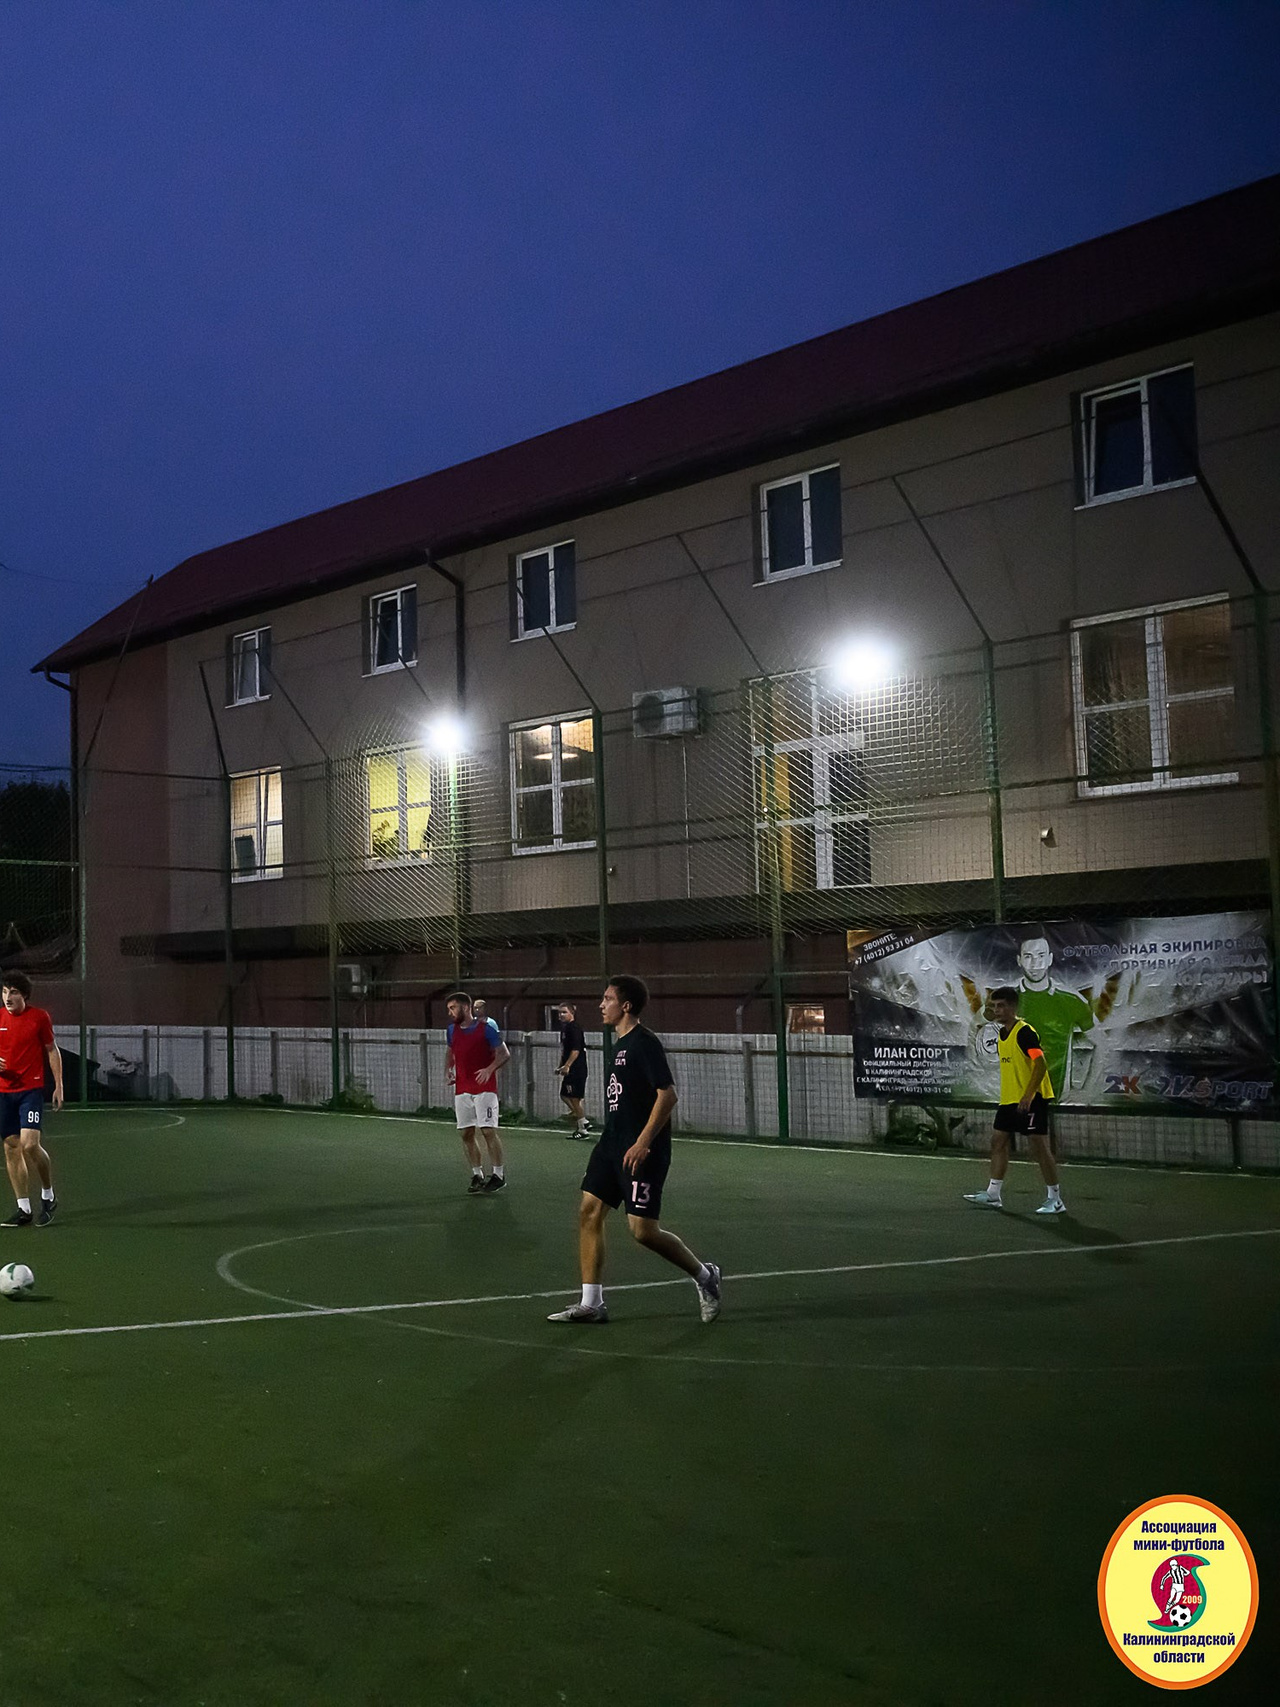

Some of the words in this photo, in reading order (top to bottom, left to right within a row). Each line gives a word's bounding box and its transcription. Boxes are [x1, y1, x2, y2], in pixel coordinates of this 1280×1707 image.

[1062, 943, 1158, 957] ФУТБОЛЬНАЯ
[1161, 937, 1267, 953] ЭКИПИРОВКА
[874, 1047, 907, 1058] ИЛАН
[909, 1047, 950, 1059] СПОРТ
[1104, 1076, 1142, 1094] 2K
[28, 1111, 40, 1123] 96
[631, 1181, 651, 1203] 13
